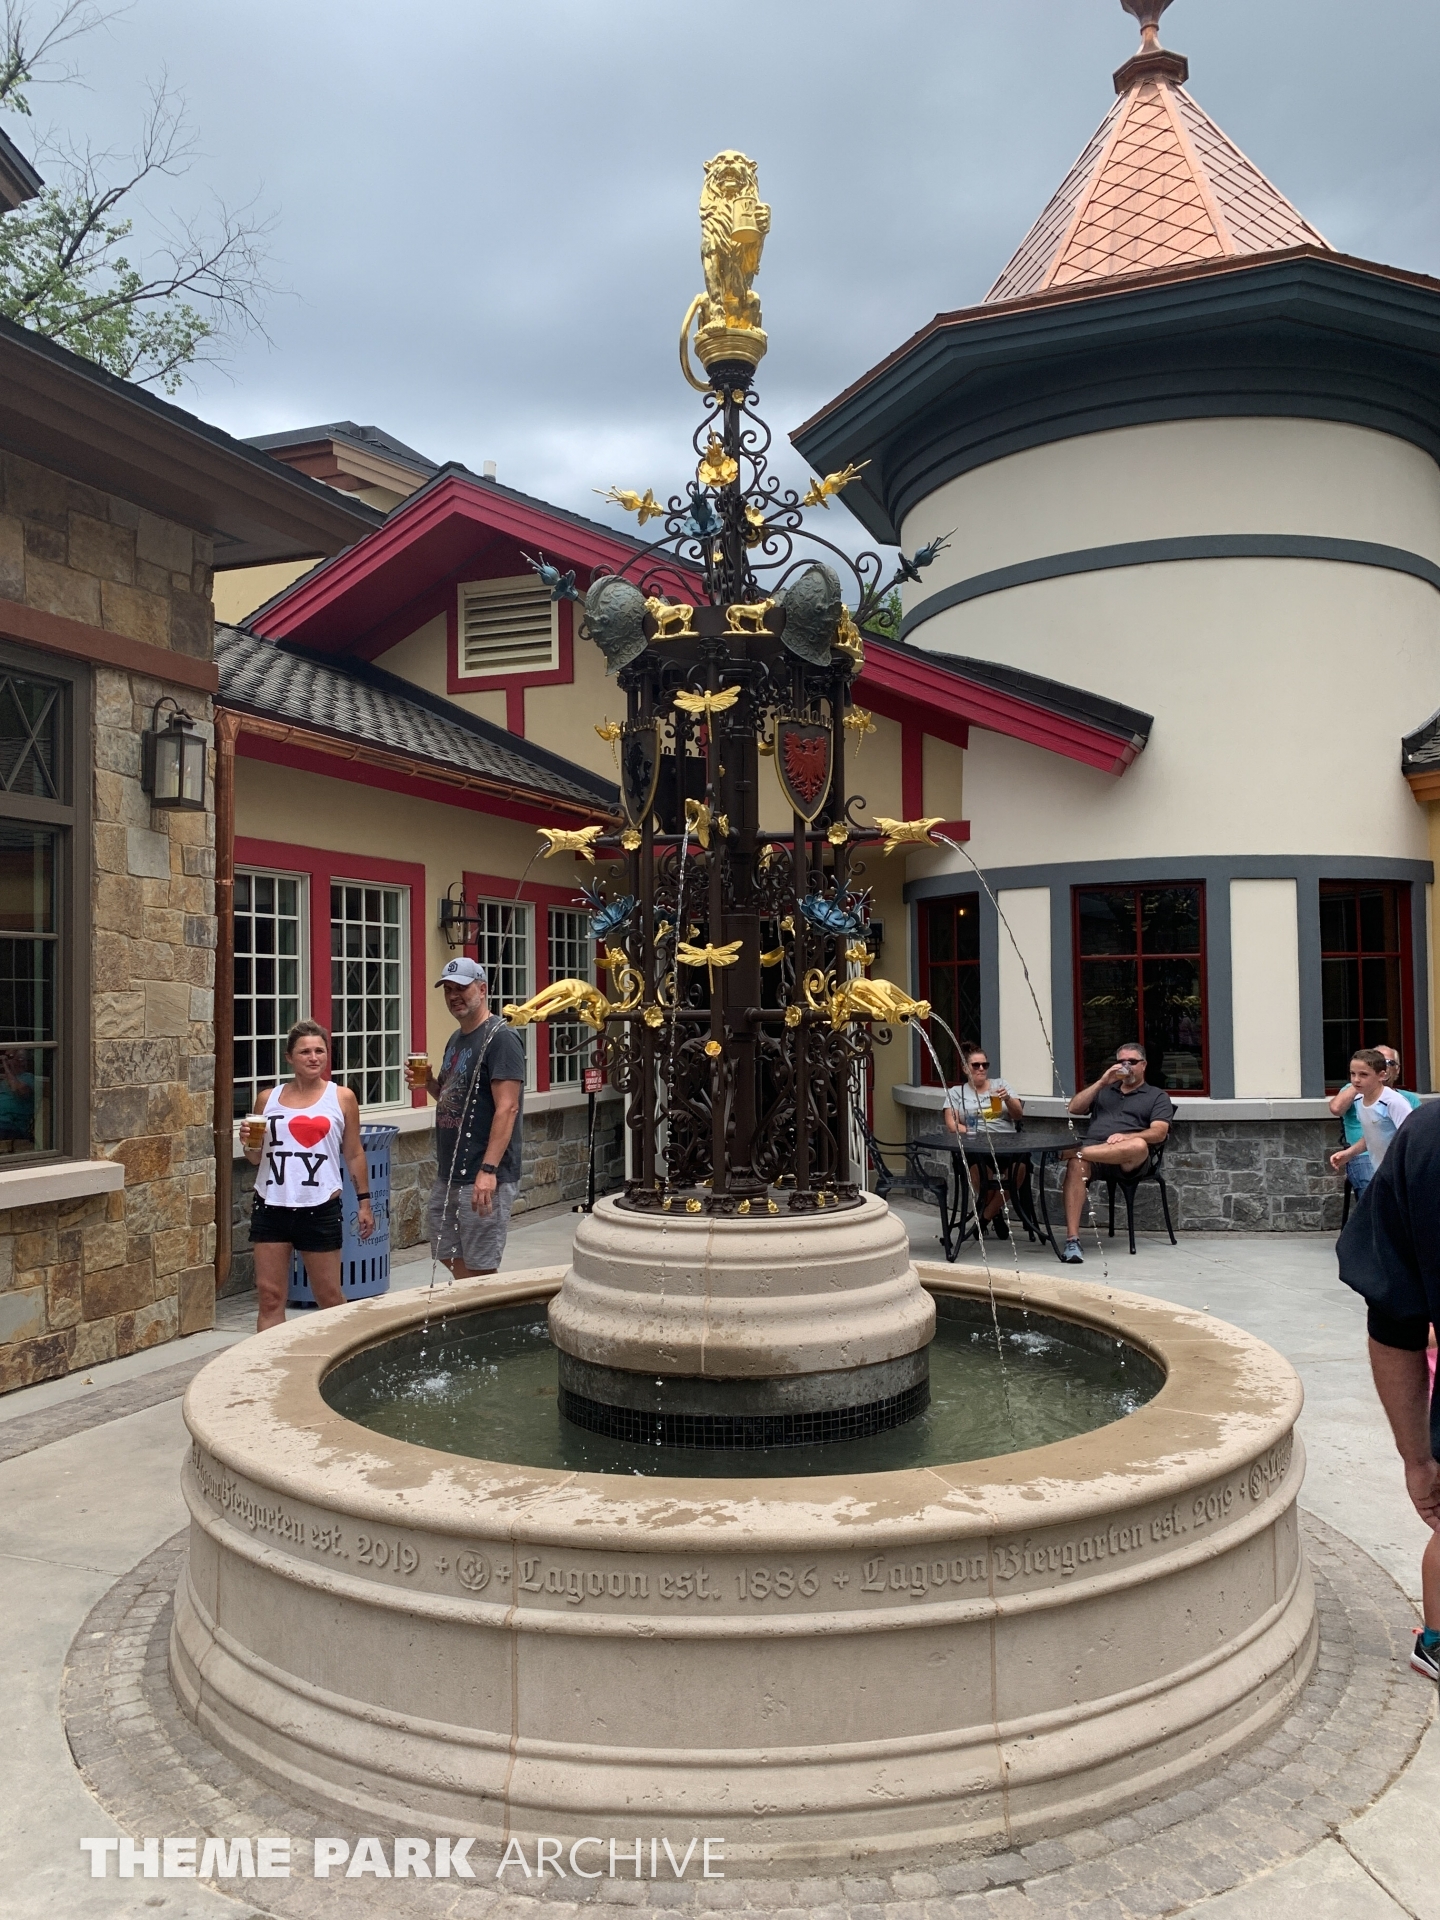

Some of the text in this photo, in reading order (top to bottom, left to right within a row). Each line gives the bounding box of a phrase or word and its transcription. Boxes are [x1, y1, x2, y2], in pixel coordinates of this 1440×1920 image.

[267, 1115, 285, 1147] I
[266, 1151, 329, 1187] NY
[312, 1525, 349, 1558] est.
[357, 1534, 420, 1574] 2019
[517, 1556, 650, 1604] Lagoon
[659, 1566, 721, 1600] est.
[734, 1565, 820, 1600] 1886
[860, 1555, 989, 1597] Lagoon
[994, 1523, 1144, 1580] Biergarten
[1151, 1503, 1187, 1542] est.
[1193, 1486, 1233, 1528] 2019
